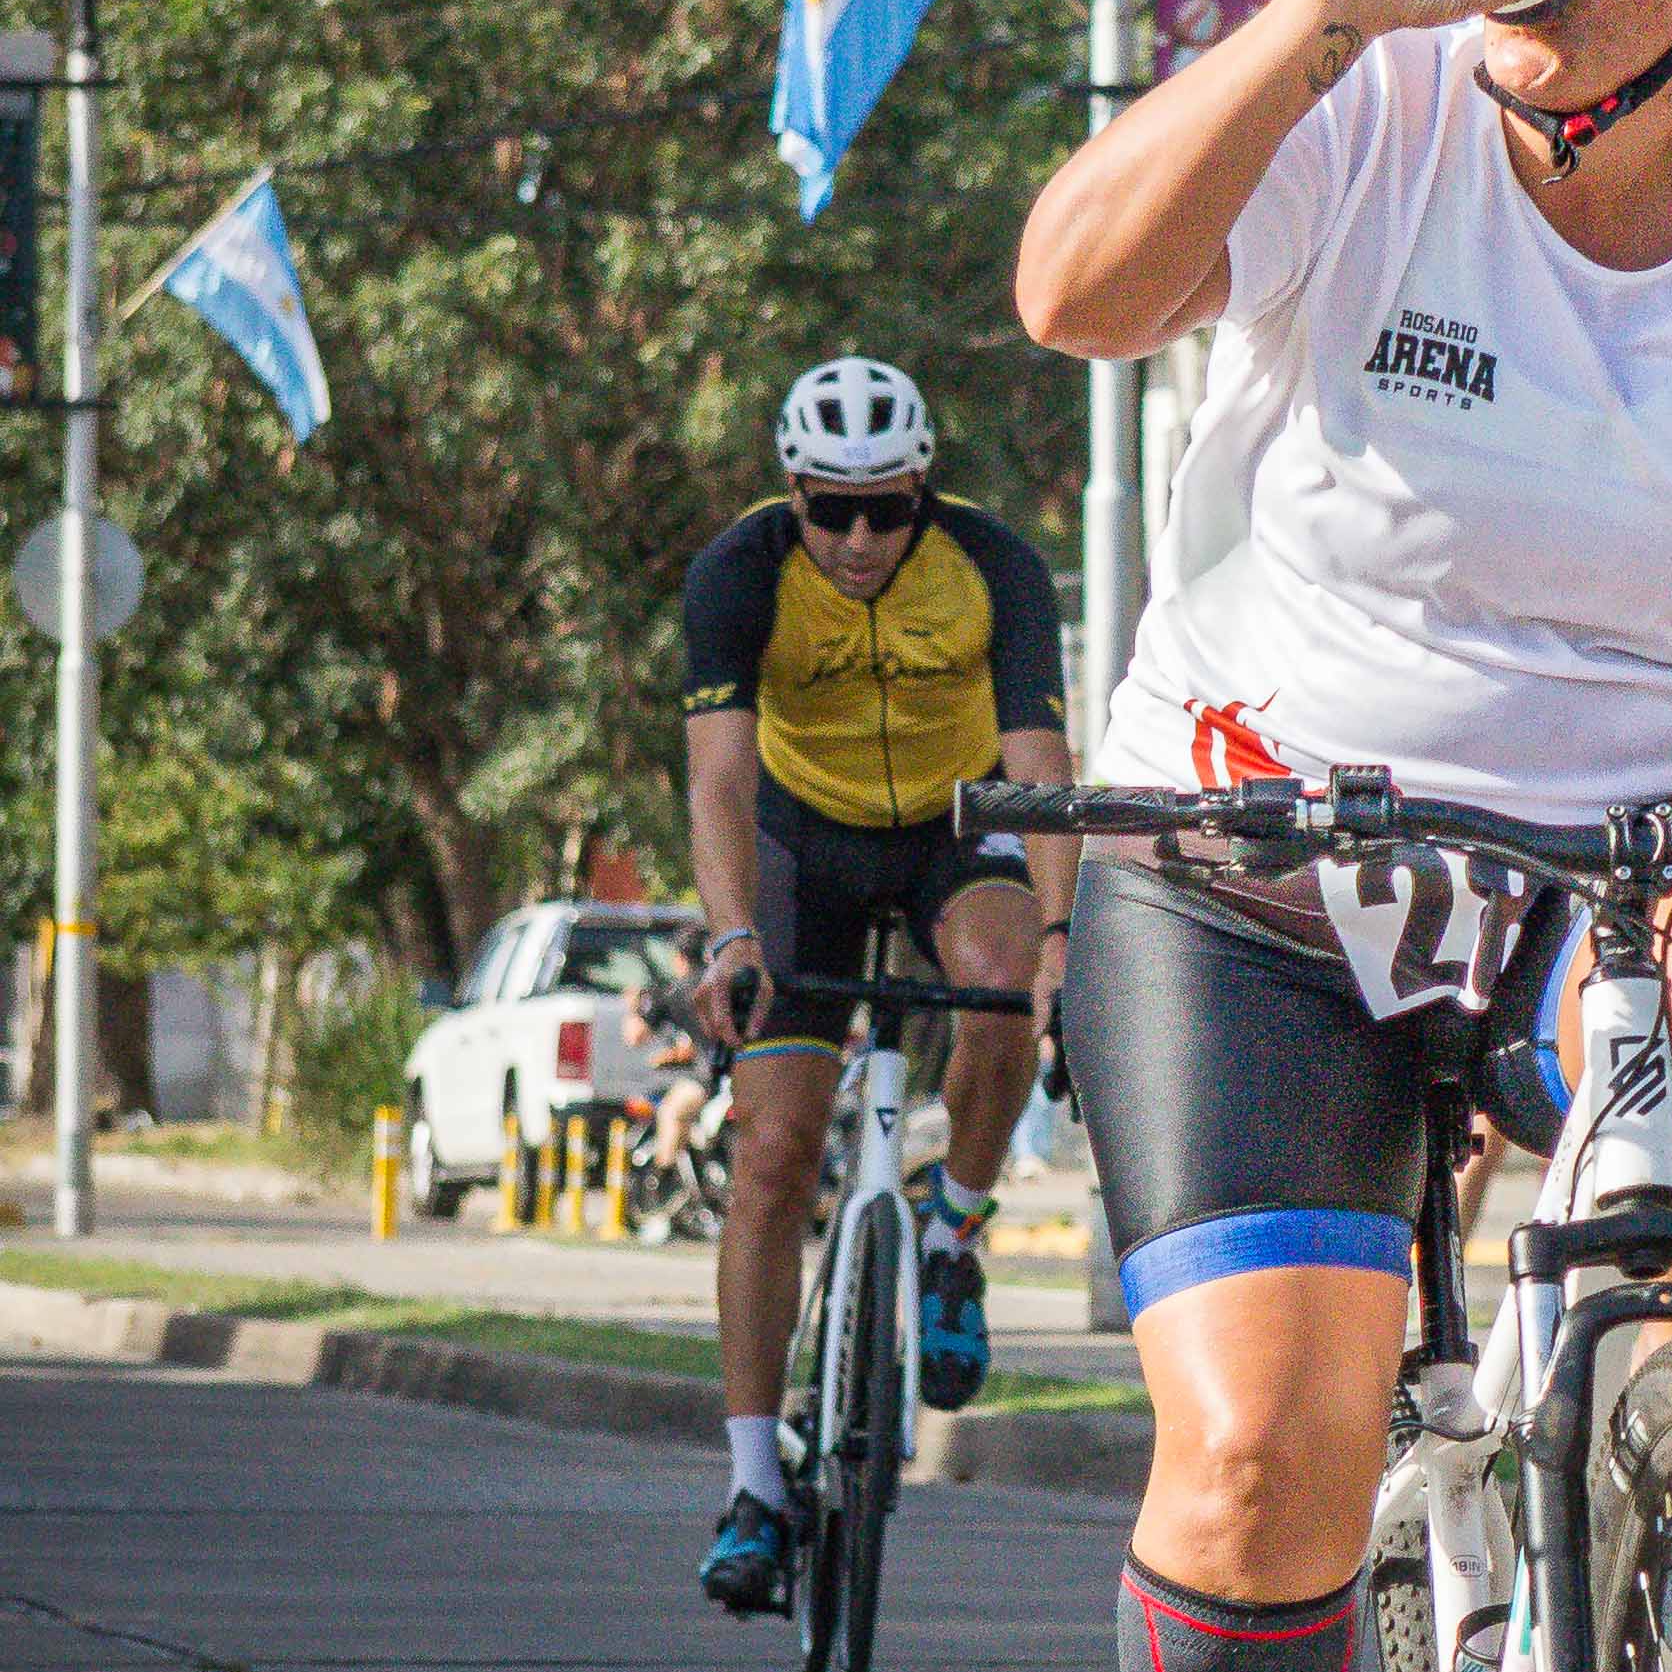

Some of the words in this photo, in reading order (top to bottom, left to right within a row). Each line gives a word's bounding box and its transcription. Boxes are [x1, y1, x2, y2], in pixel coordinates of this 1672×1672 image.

[1399, 308, 1479, 344] ROSARIO
[1362, 328, 1498, 403] ARENA
[1377, 377, 1473, 410] SPORTS
